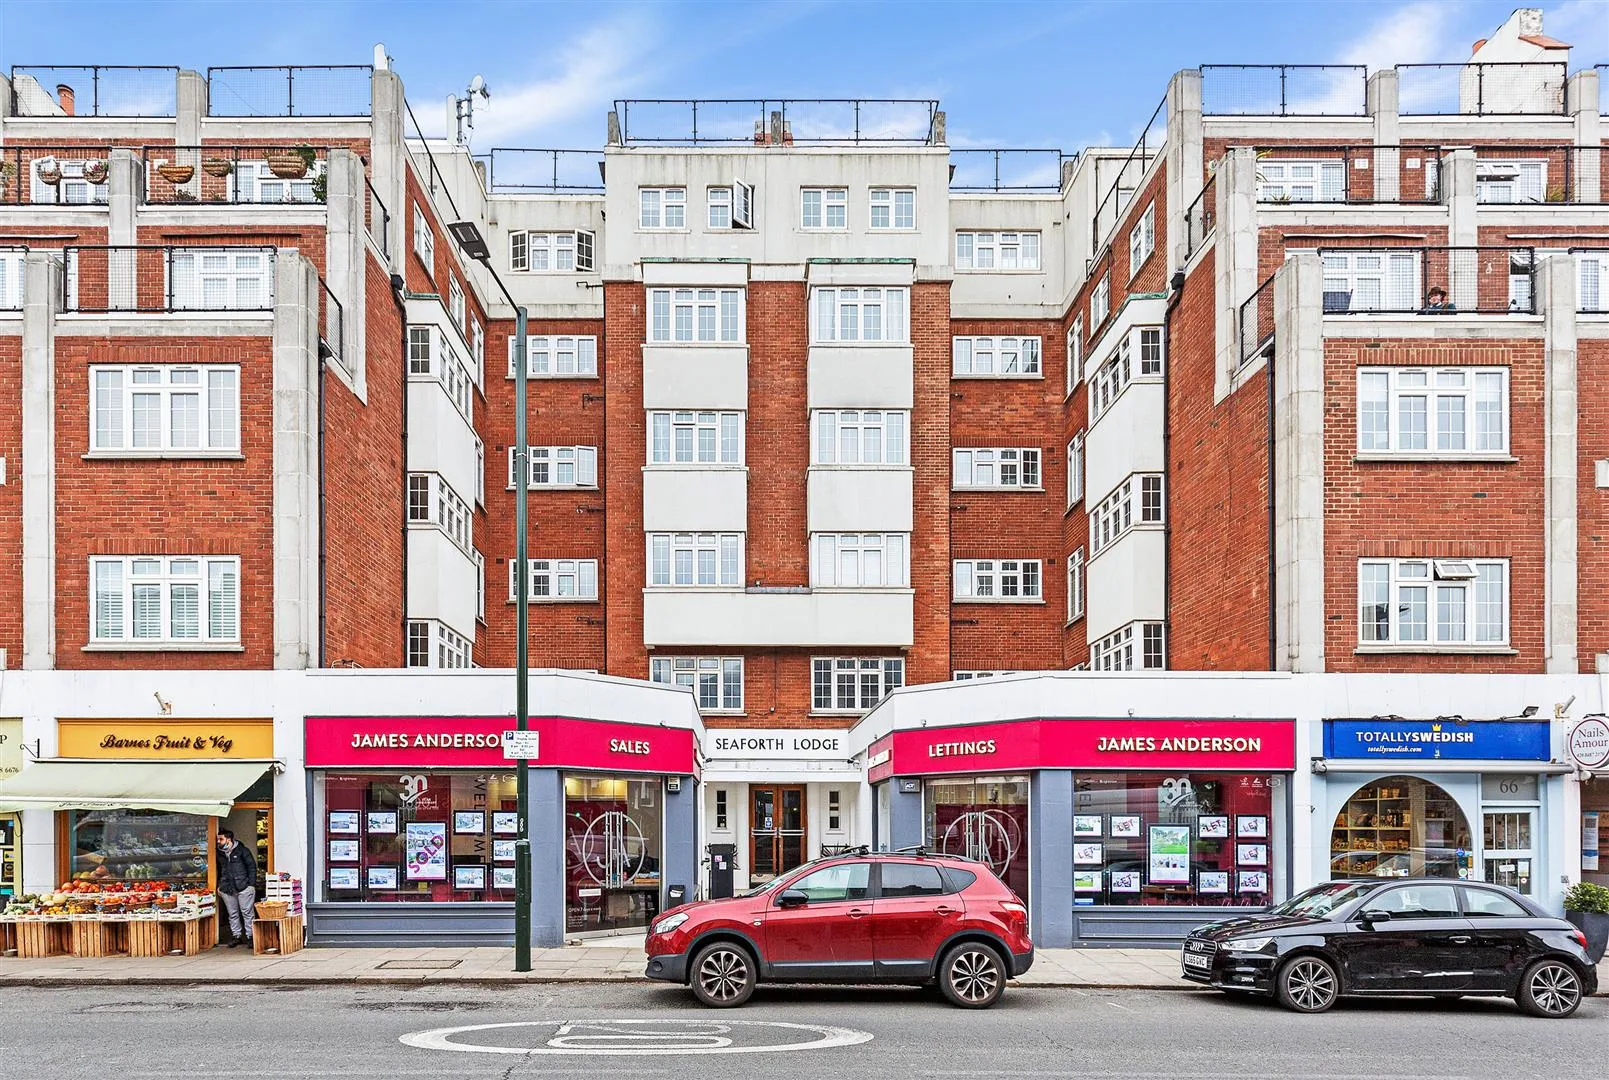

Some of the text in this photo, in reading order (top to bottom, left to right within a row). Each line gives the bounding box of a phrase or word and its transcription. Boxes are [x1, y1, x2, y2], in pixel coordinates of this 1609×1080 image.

[1356, 731, 1474, 743] TOTALLYSWEDISH
[1578, 728, 1604, 738] Nails
[100, 734, 233, 752] Barnes Fruit & Veg
[351, 733, 504, 748] JAMES ANDERSO
[609, 739, 650, 755] SALES
[715, 738, 839, 750] SEAFORTH LODGE
[1097, 737, 1261, 752] JAMES ANDERSON
[1573, 739, 1608, 749] Amour
[928, 740, 996, 757] LETTINGS
[1367, 745, 1422, 754] totallyswedish.com
[1500, 779, 1519, 793] 66
[1205, 819, 1222, 832] LET
[1243, 819, 1259, 832] LET
[408, 834, 445, 874] SOLD
[1078, 847, 1094, 859] LET
[1243, 847, 1259, 861] LET
